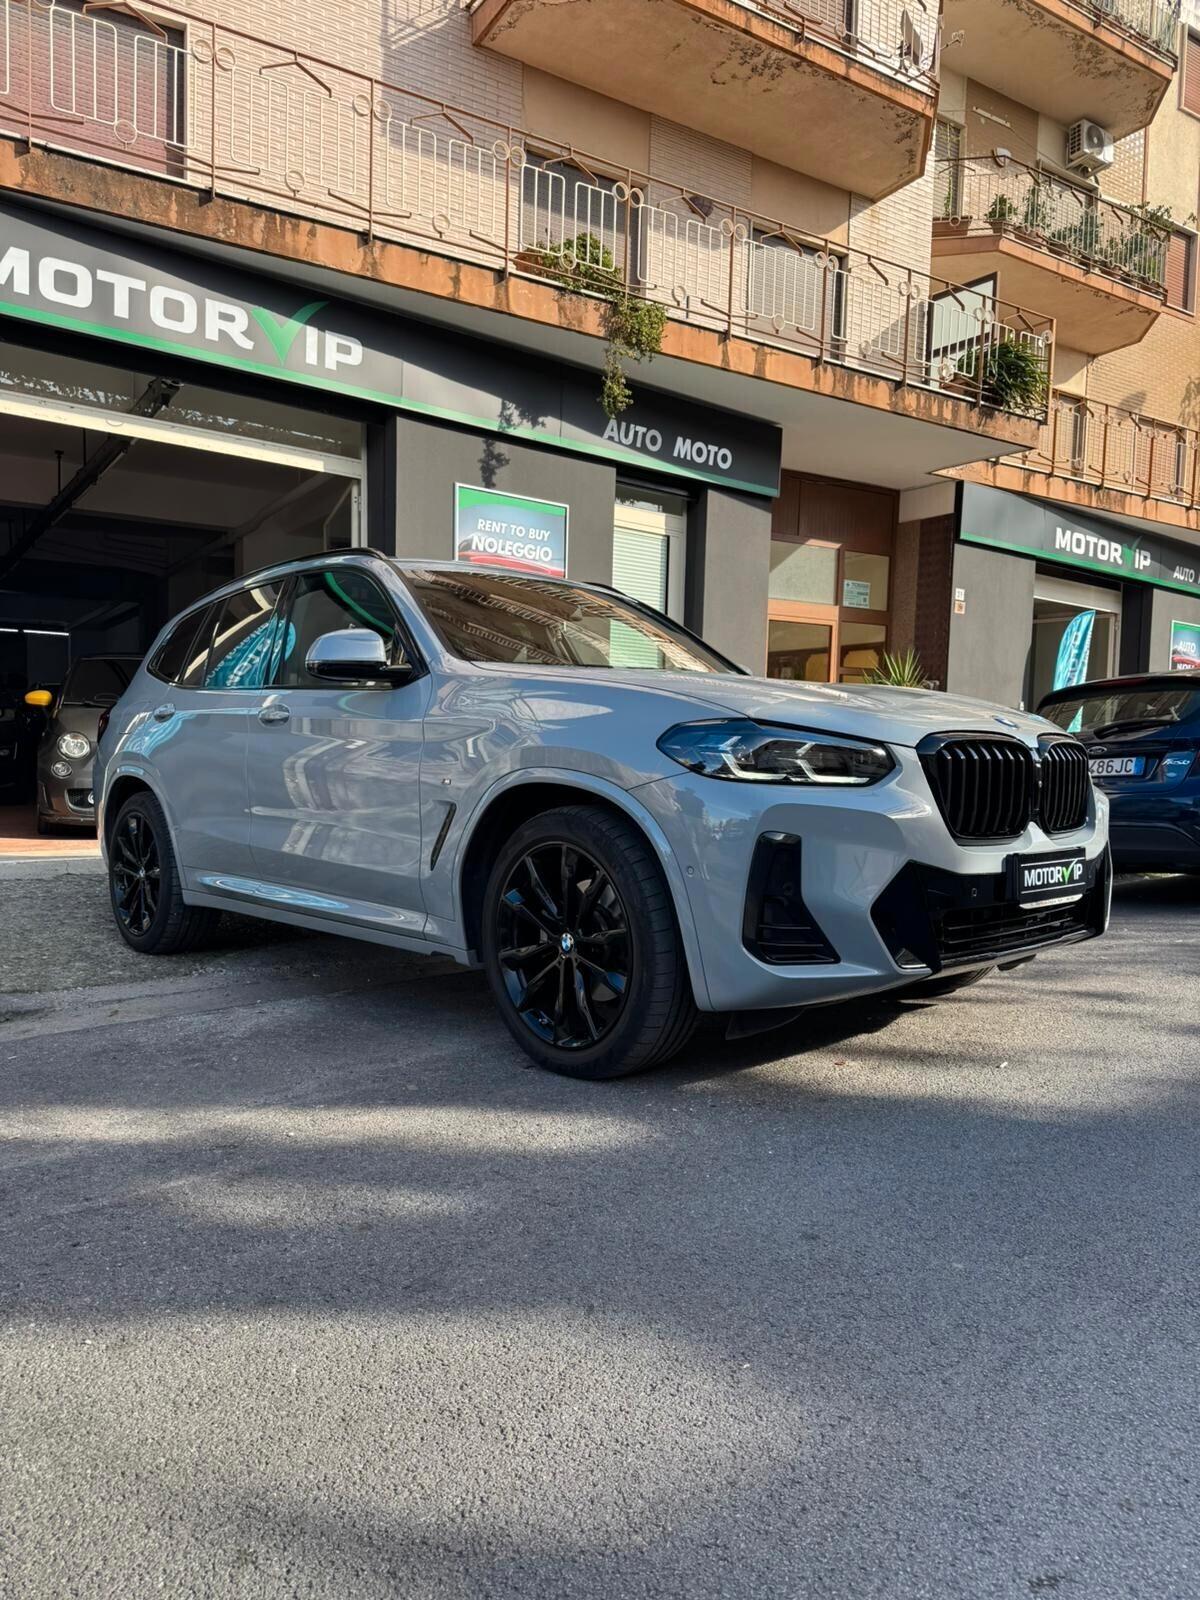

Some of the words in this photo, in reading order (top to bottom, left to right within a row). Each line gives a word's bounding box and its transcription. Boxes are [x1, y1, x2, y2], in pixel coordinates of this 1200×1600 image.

[602, 415, 663, 453] AUTO
[673, 436, 733, 470] MOTO
[477, 518, 507, 534] RENT
[510, 524, 526, 538] TO
[528, 528, 551, 542] BUY
[471, 534, 553, 562] NOLEGGIO
[1173, 565, 1195, 583] AUTO
[1024, 859, 1083, 888] MOTORVIP
